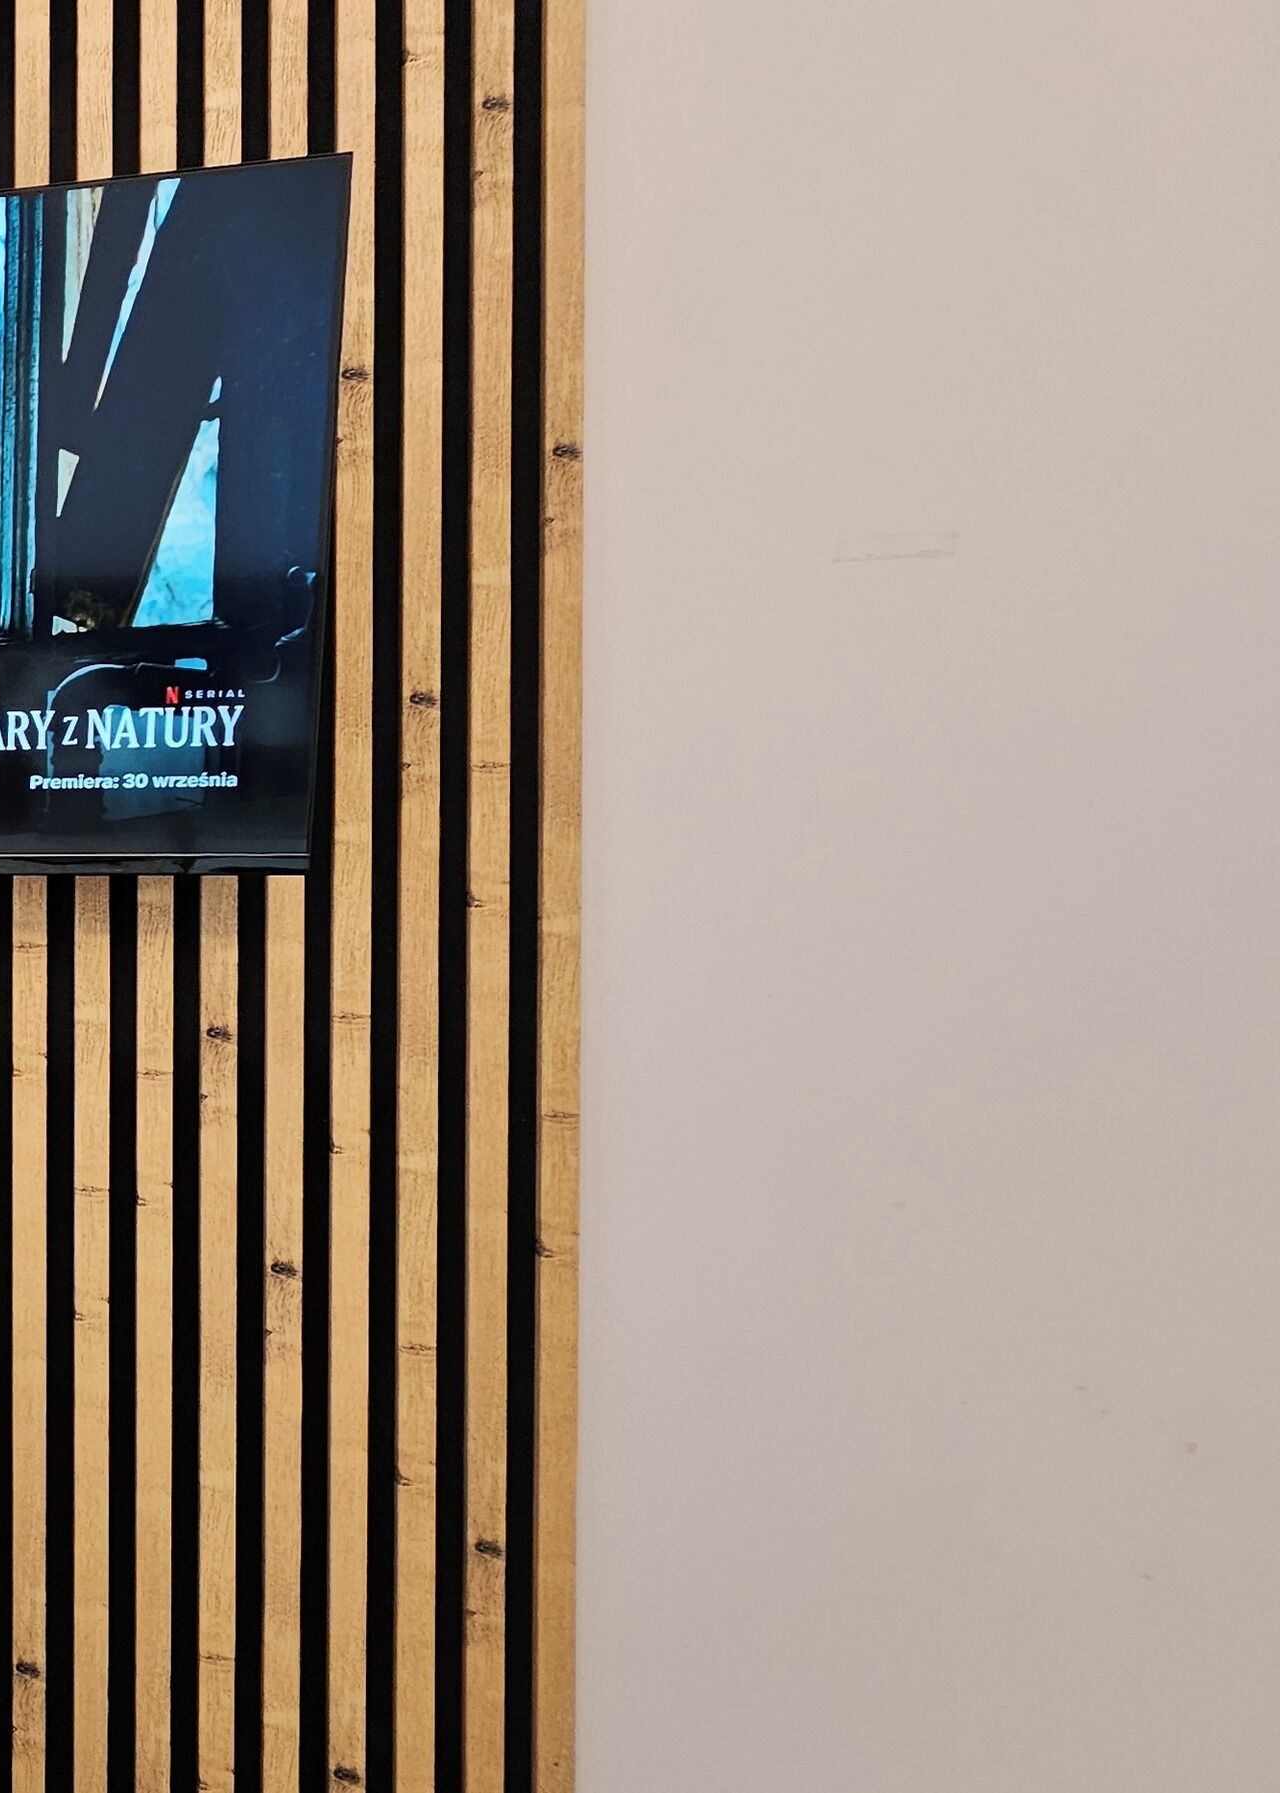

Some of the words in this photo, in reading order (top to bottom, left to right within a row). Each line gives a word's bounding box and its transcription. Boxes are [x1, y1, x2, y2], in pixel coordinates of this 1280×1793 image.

[185, 689, 246, 700] SERIAL
[85, 704, 244, 751] NATURY
[29, 774, 120, 790] Premiera:
[123, 773, 149, 788] 30
[152, 770, 238, 788] września
